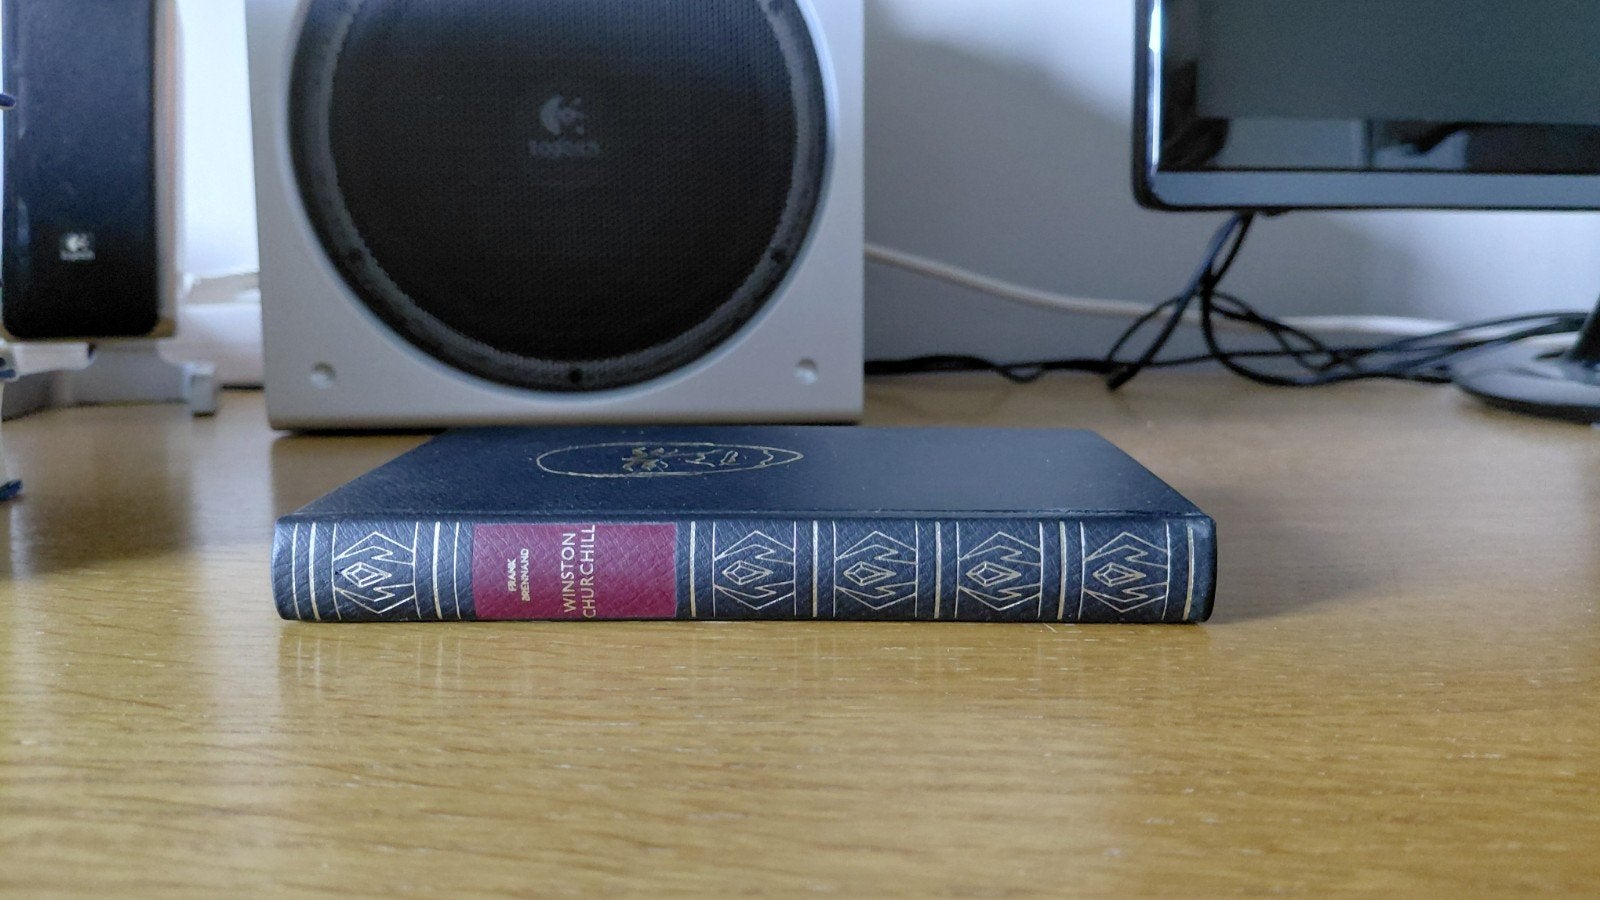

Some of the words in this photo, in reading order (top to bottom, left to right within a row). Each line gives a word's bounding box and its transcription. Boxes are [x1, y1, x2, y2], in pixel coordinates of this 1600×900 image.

[507, 557, 517, 592] FRANK
[520, 548, 530, 602] BRENNAND
[560, 532, 577, 613] WINSTON
[580, 524, 597, 619] CHURCHILL
